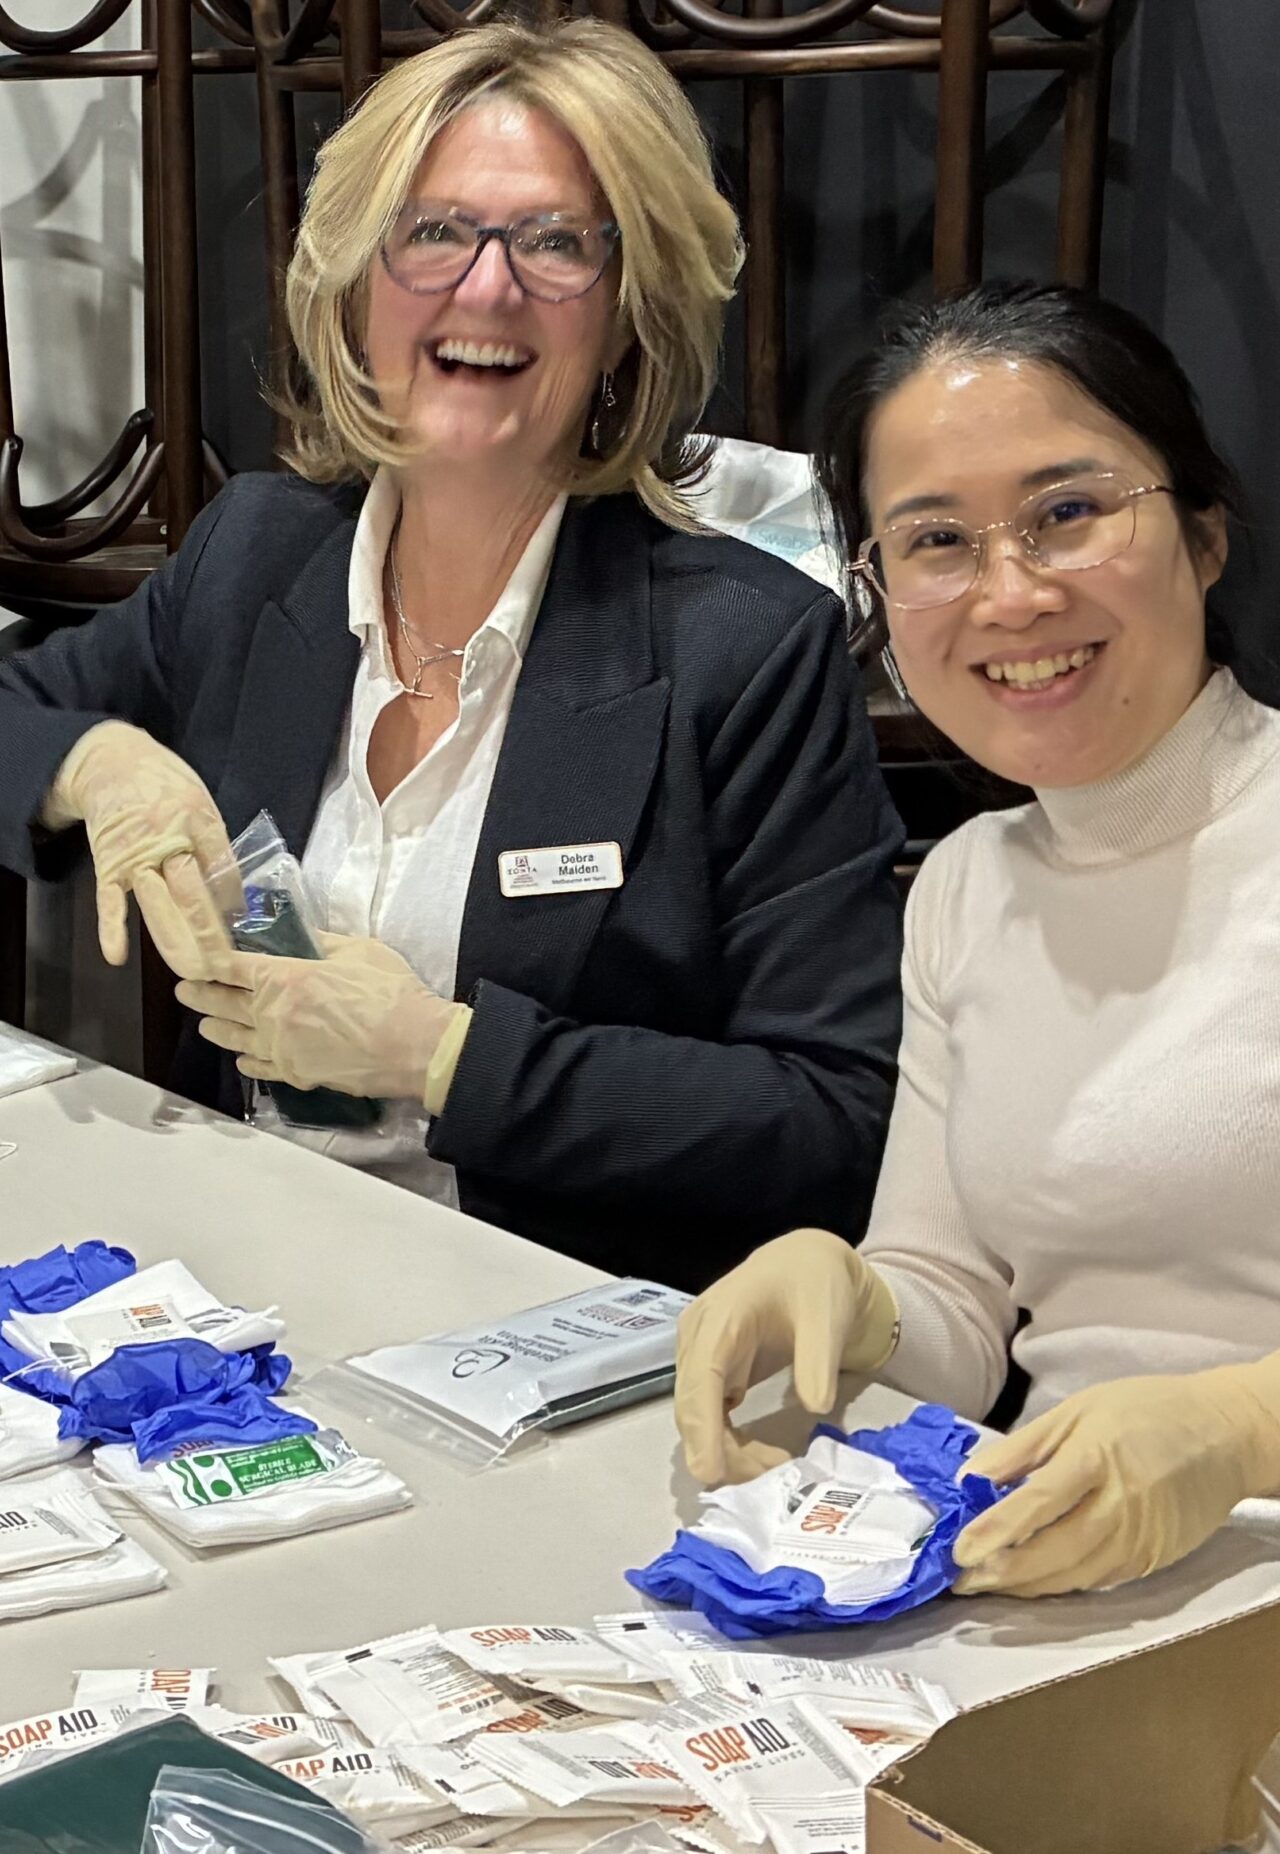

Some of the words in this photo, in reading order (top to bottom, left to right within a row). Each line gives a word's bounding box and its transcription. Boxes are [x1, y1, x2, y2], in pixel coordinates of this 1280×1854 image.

[561, 853, 595, 864] Debra
[819, 1490, 862, 1509] AID
[800, 1505, 849, 1535] SOAP
[470, 1628, 532, 1648] SOAP
[532, 1628, 577, 1642] AID
[150, 1669, 192, 1694] OAP
[533, 1698, 584, 1720] AID
[57, 1709, 98, 1736] AID
[686, 1726, 751, 1772] SOAP
[740, 1718, 791, 1756] AID
[278, 1759, 326, 1778] OAP
[332, 1753, 373, 1774] AID
